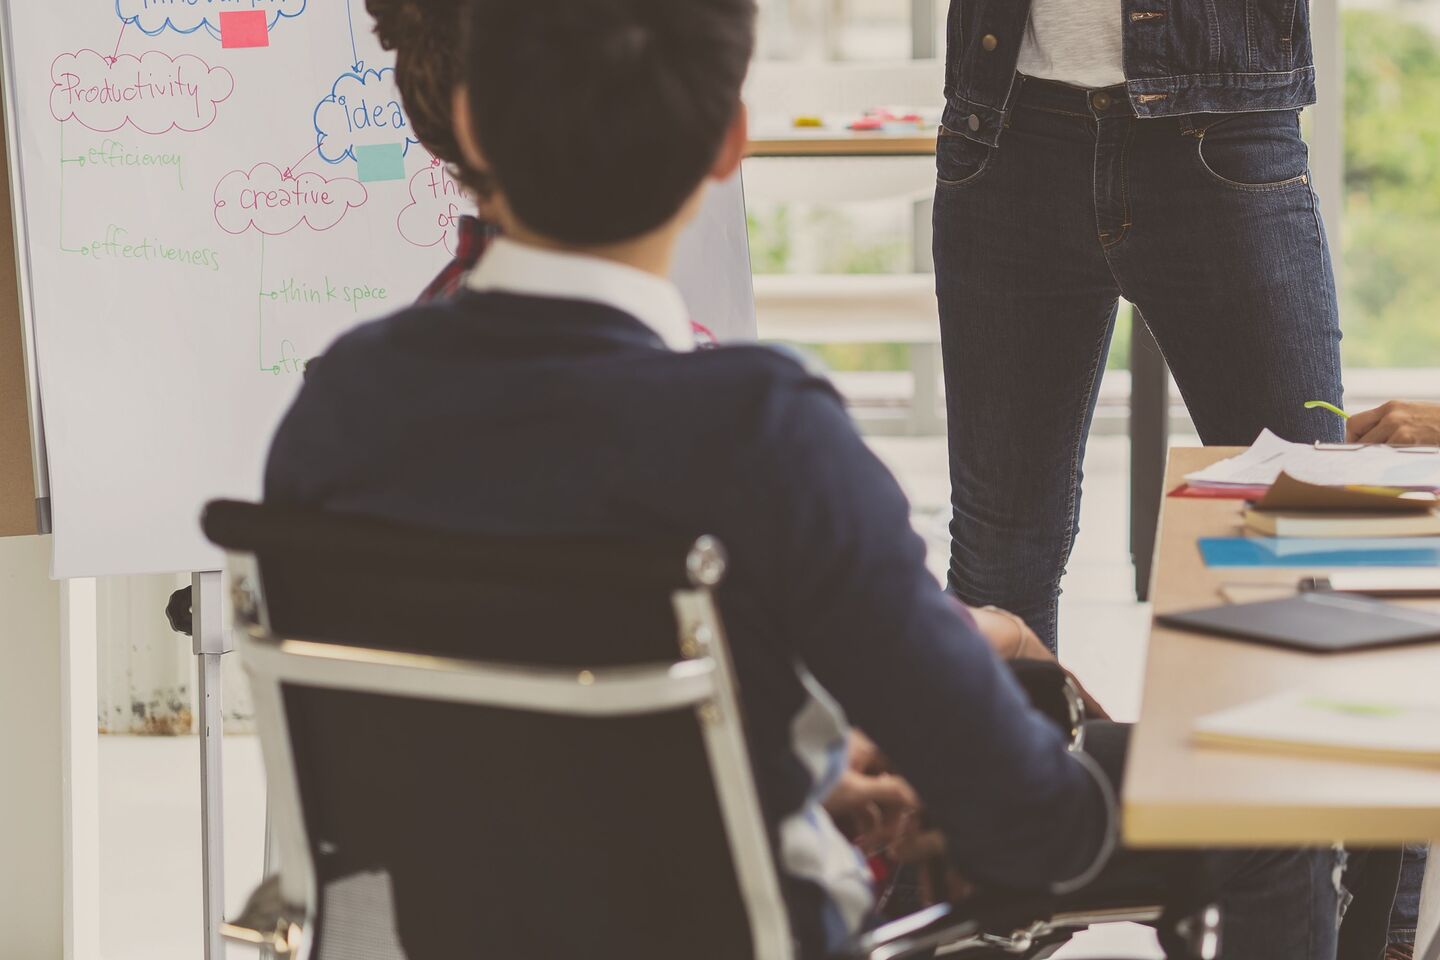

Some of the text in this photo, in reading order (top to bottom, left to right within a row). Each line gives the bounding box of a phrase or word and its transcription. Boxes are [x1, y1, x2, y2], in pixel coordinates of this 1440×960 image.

[60, 66, 200, 118] Productivity
[88, 138, 184, 191] efficiency
[90, 223, 220, 272] effectiveness
[343, 284, 388, 313] space
